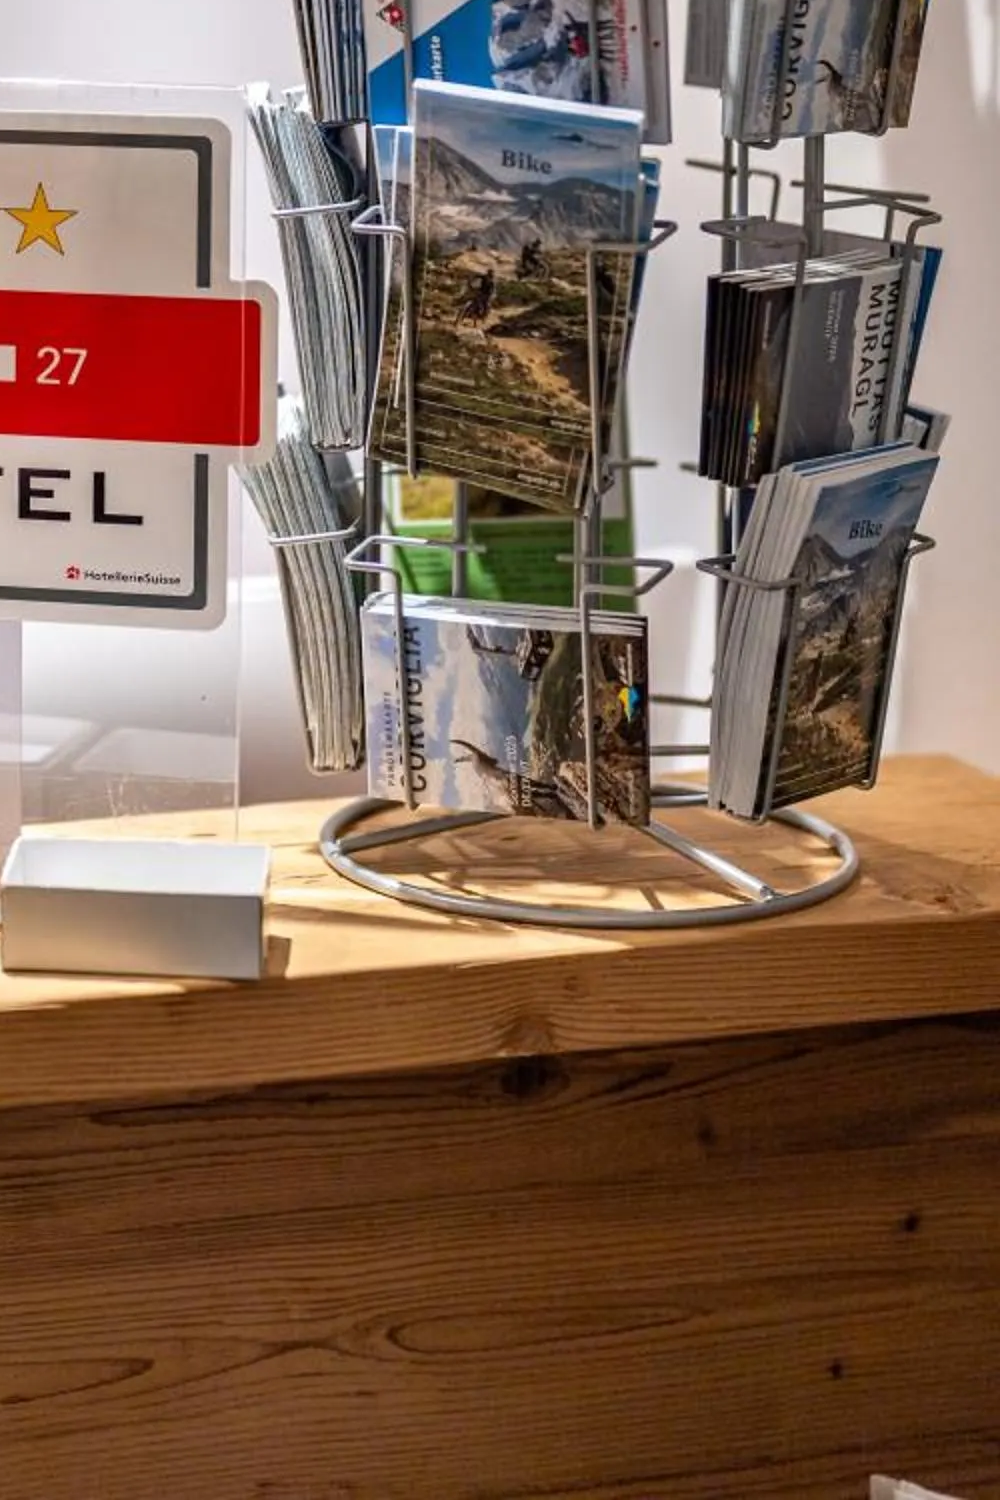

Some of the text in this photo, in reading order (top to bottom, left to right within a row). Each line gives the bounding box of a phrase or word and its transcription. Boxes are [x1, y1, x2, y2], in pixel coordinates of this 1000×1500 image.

[501, 149, 553, 175] Bike
[851, 283, 886, 418] MURAGL
[35, 347, 88, 386] 27
[848, 519, 884, 540] Bike
[82, 569, 182, 586] HotellerieSuisse
